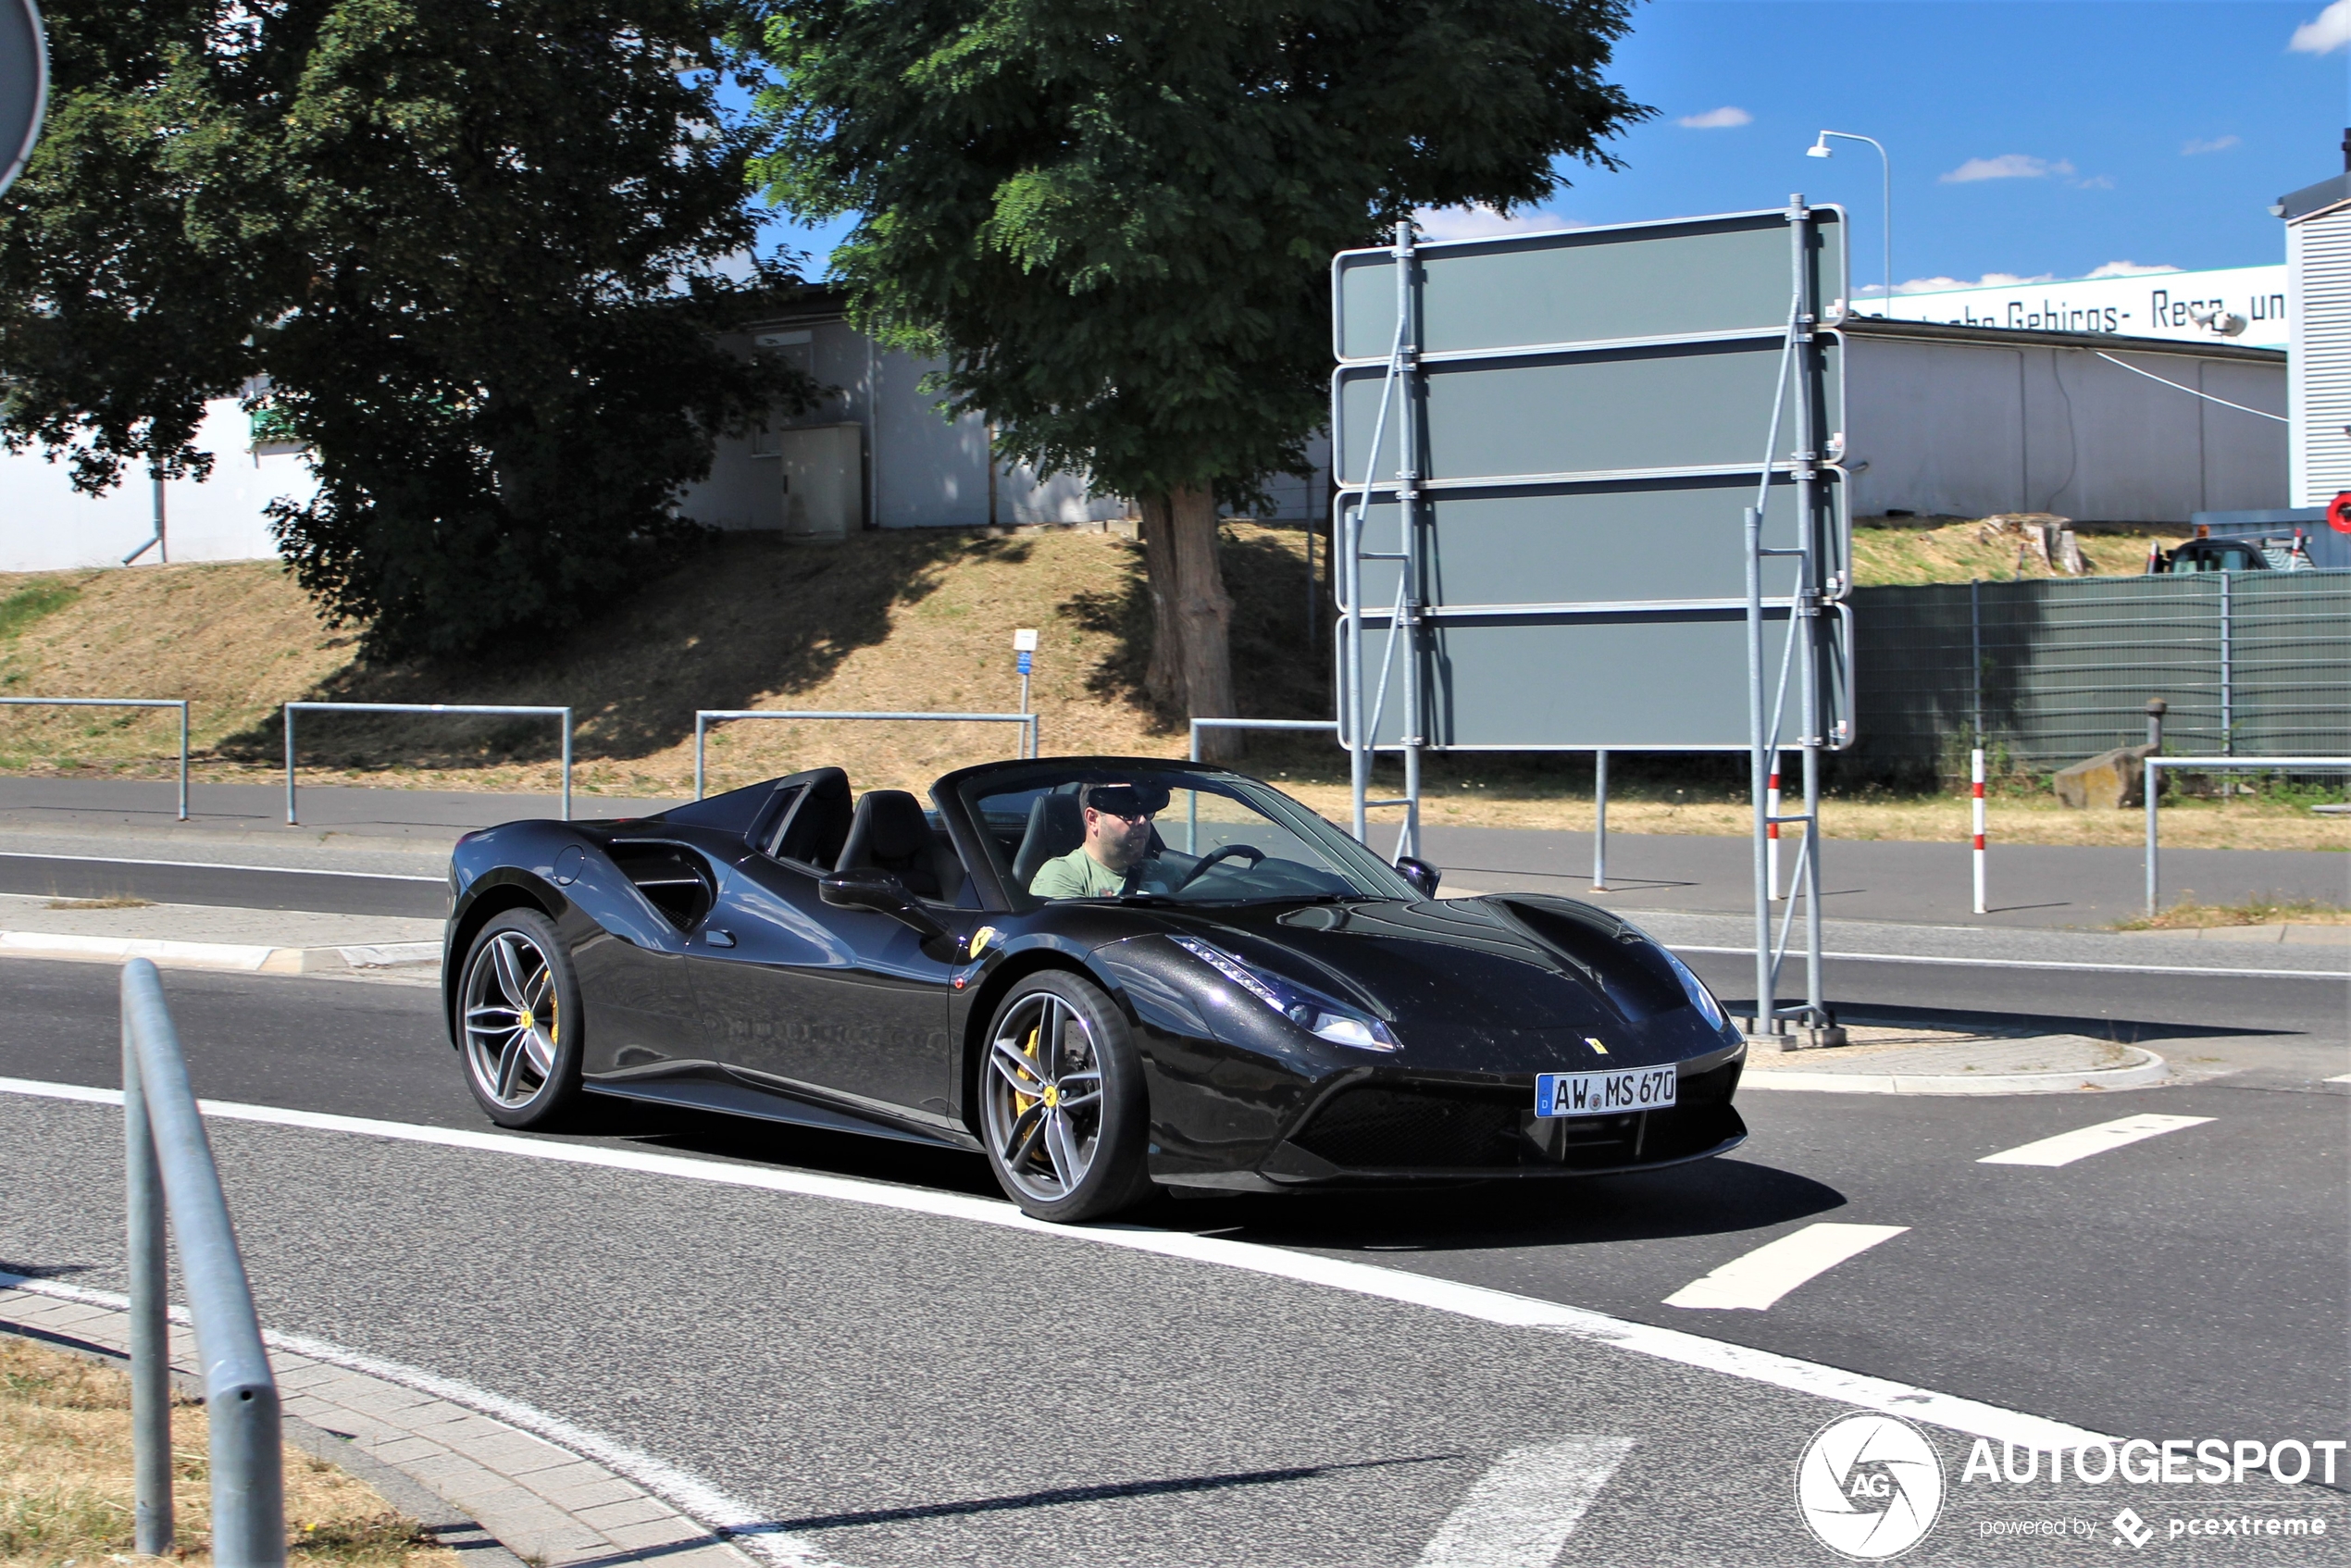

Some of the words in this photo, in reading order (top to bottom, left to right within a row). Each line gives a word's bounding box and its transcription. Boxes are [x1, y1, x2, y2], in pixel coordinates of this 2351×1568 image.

[1554, 1078, 1588, 1110] AW
[1605, 1076, 1634, 1106] MS
[1639, 1070, 1674, 1103] 670
[1541, 1100, 1549, 1109] D
